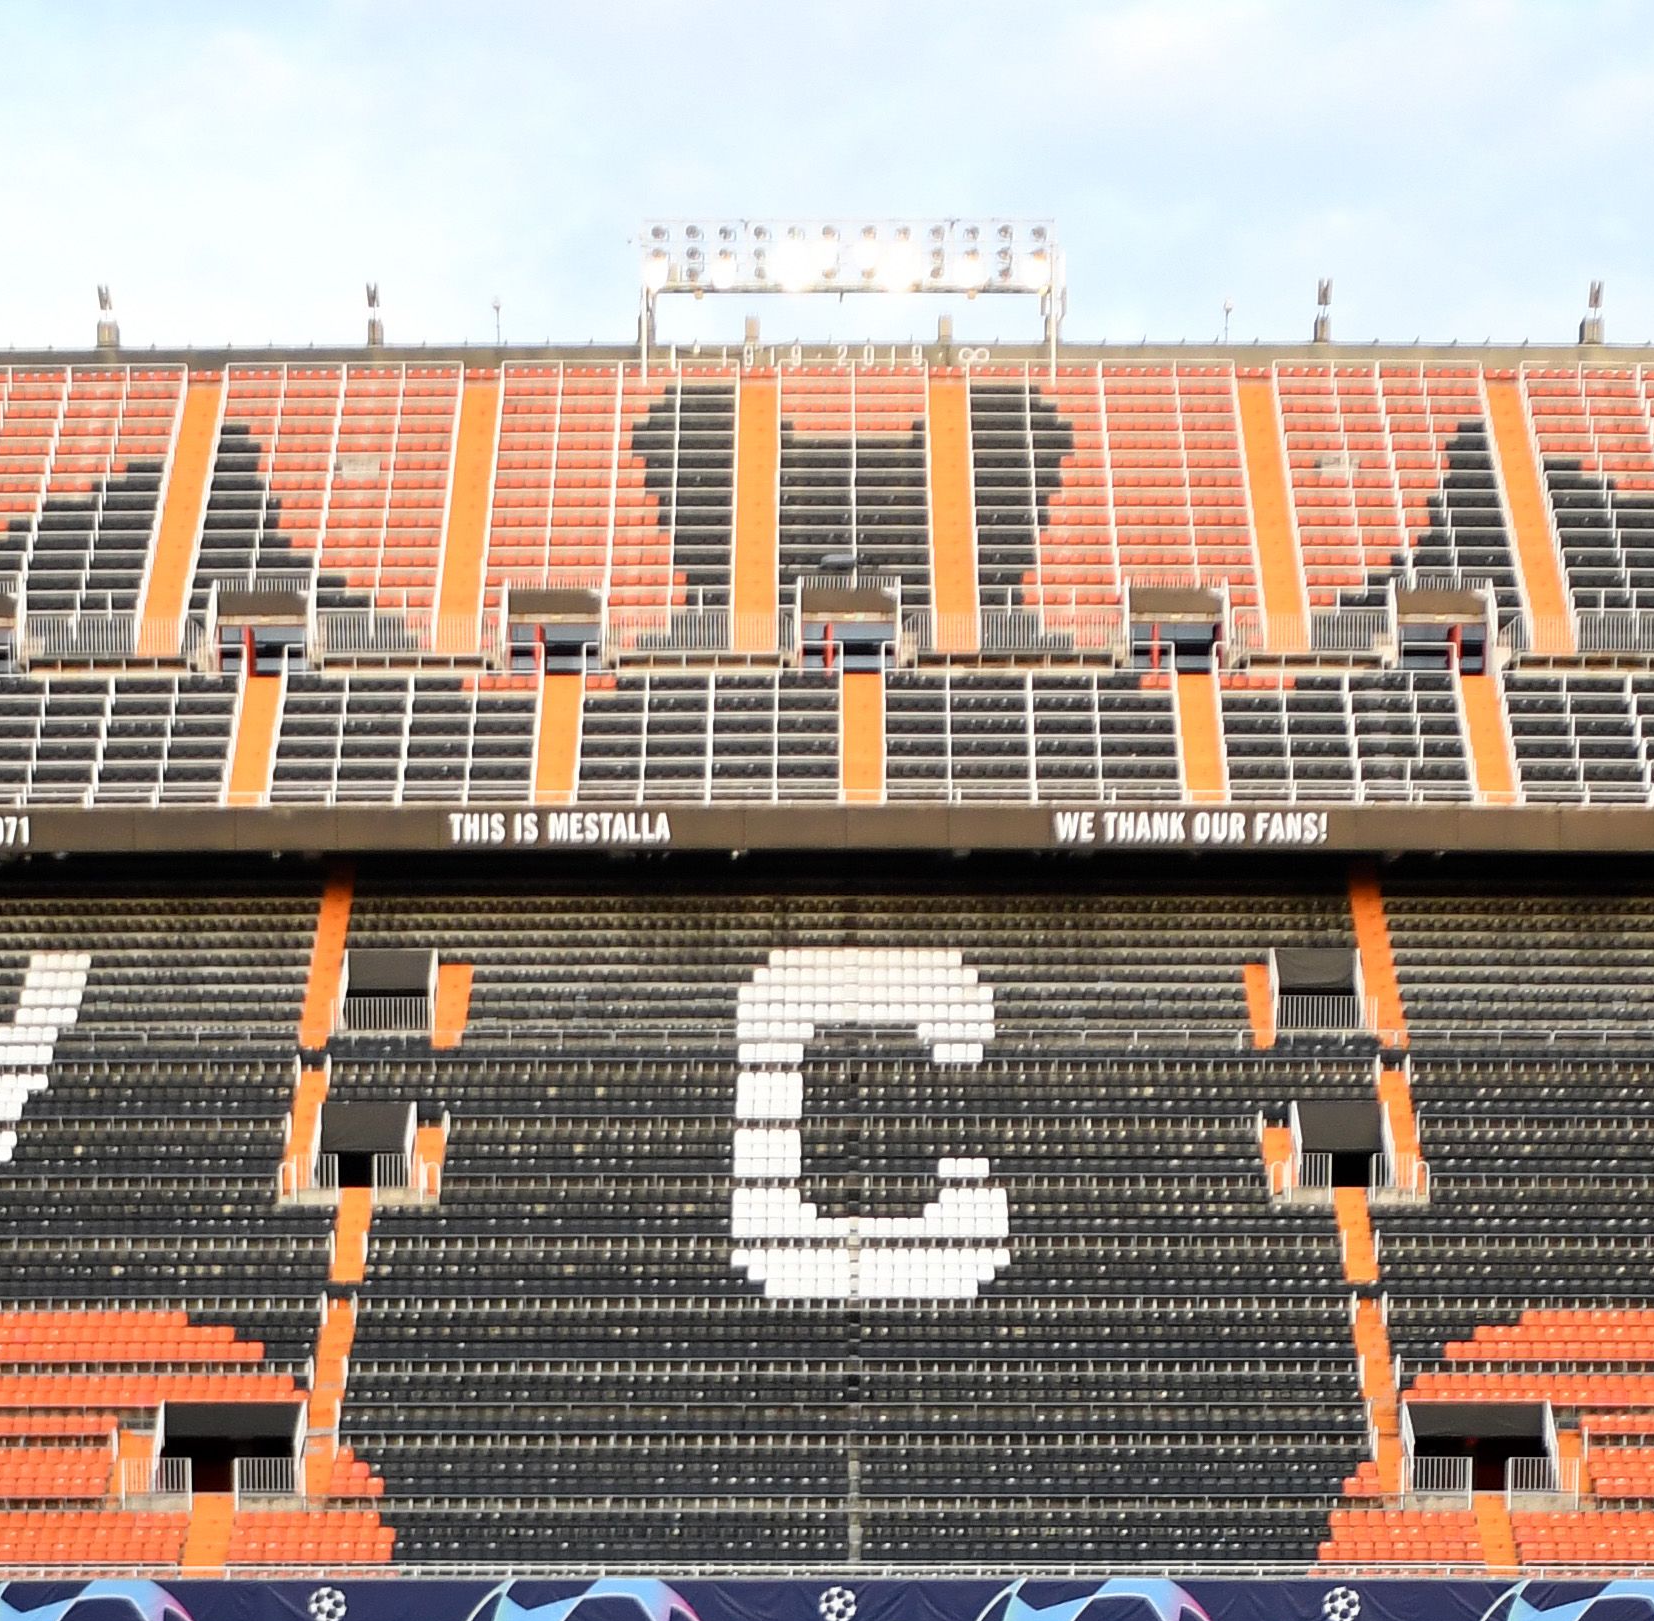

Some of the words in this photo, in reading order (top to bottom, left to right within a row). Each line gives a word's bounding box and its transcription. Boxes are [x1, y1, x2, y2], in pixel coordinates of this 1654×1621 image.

[448, 812, 505, 843] THIS
[514, 812, 538, 843] IS
[548, 812, 671, 843] MESTALLA
[1055, 811, 1096, 843] WE
[1103, 811, 1186, 843] THANK
[1194, 811, 1246, 843] OUR
[1254, 811, 1329, 843] FANS!
